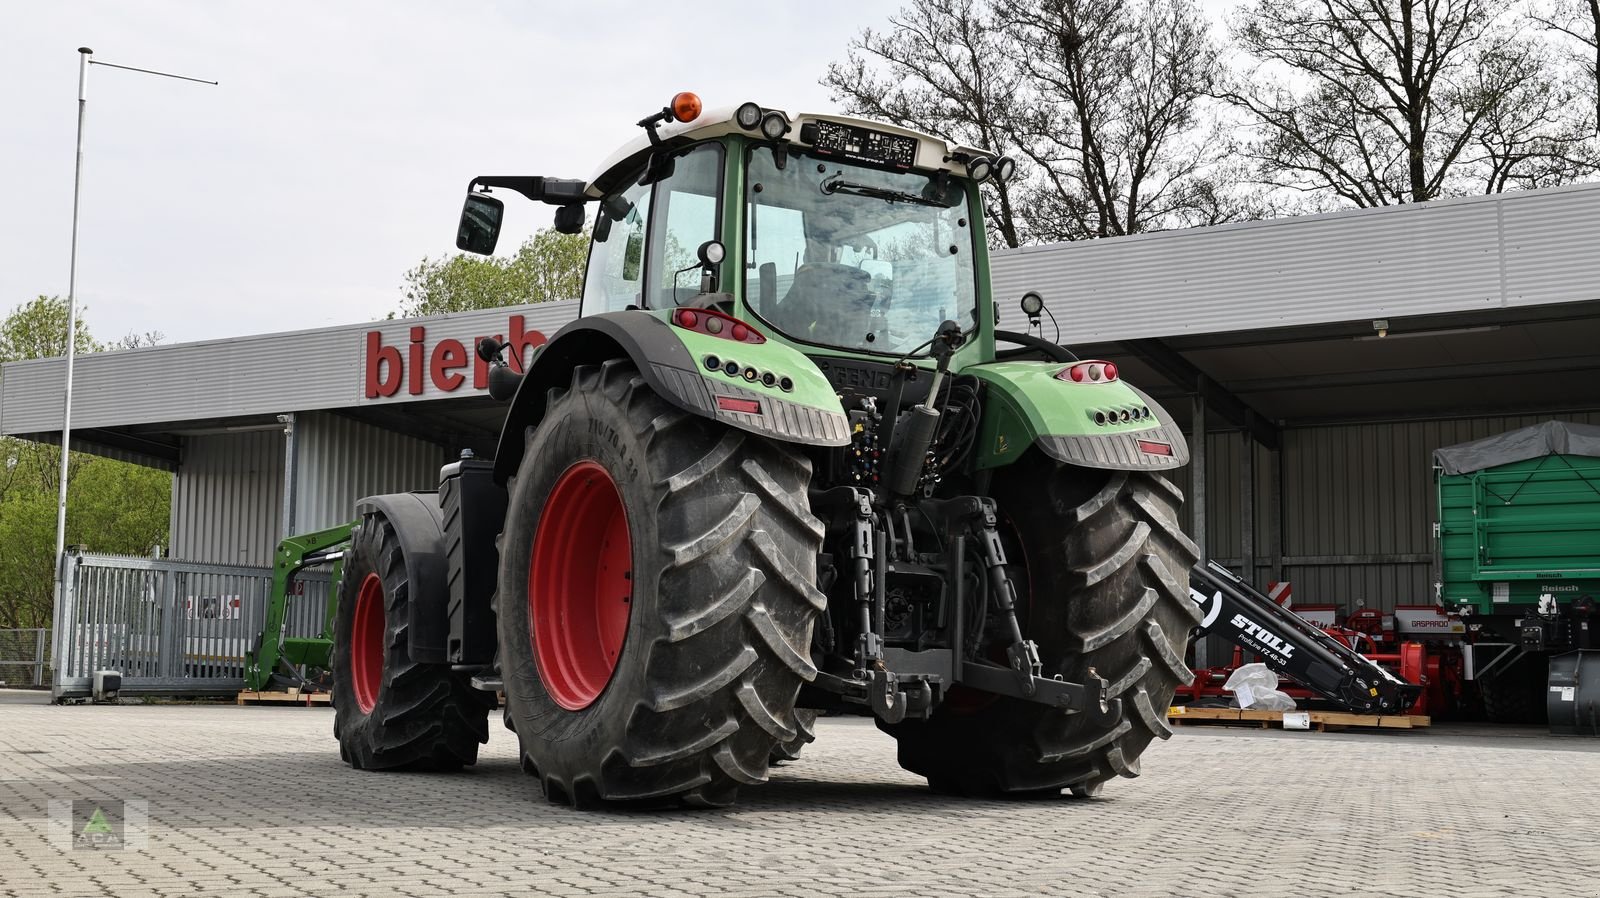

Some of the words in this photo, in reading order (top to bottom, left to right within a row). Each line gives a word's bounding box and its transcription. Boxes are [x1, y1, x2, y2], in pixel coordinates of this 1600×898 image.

[1230, 613, 1296, 659] STOLL
[1238, 634, 1262, 651] ProfiLine
[1261, 648, 1271, 656] FZ
[1269, 653, 1287, 666] 48-33
